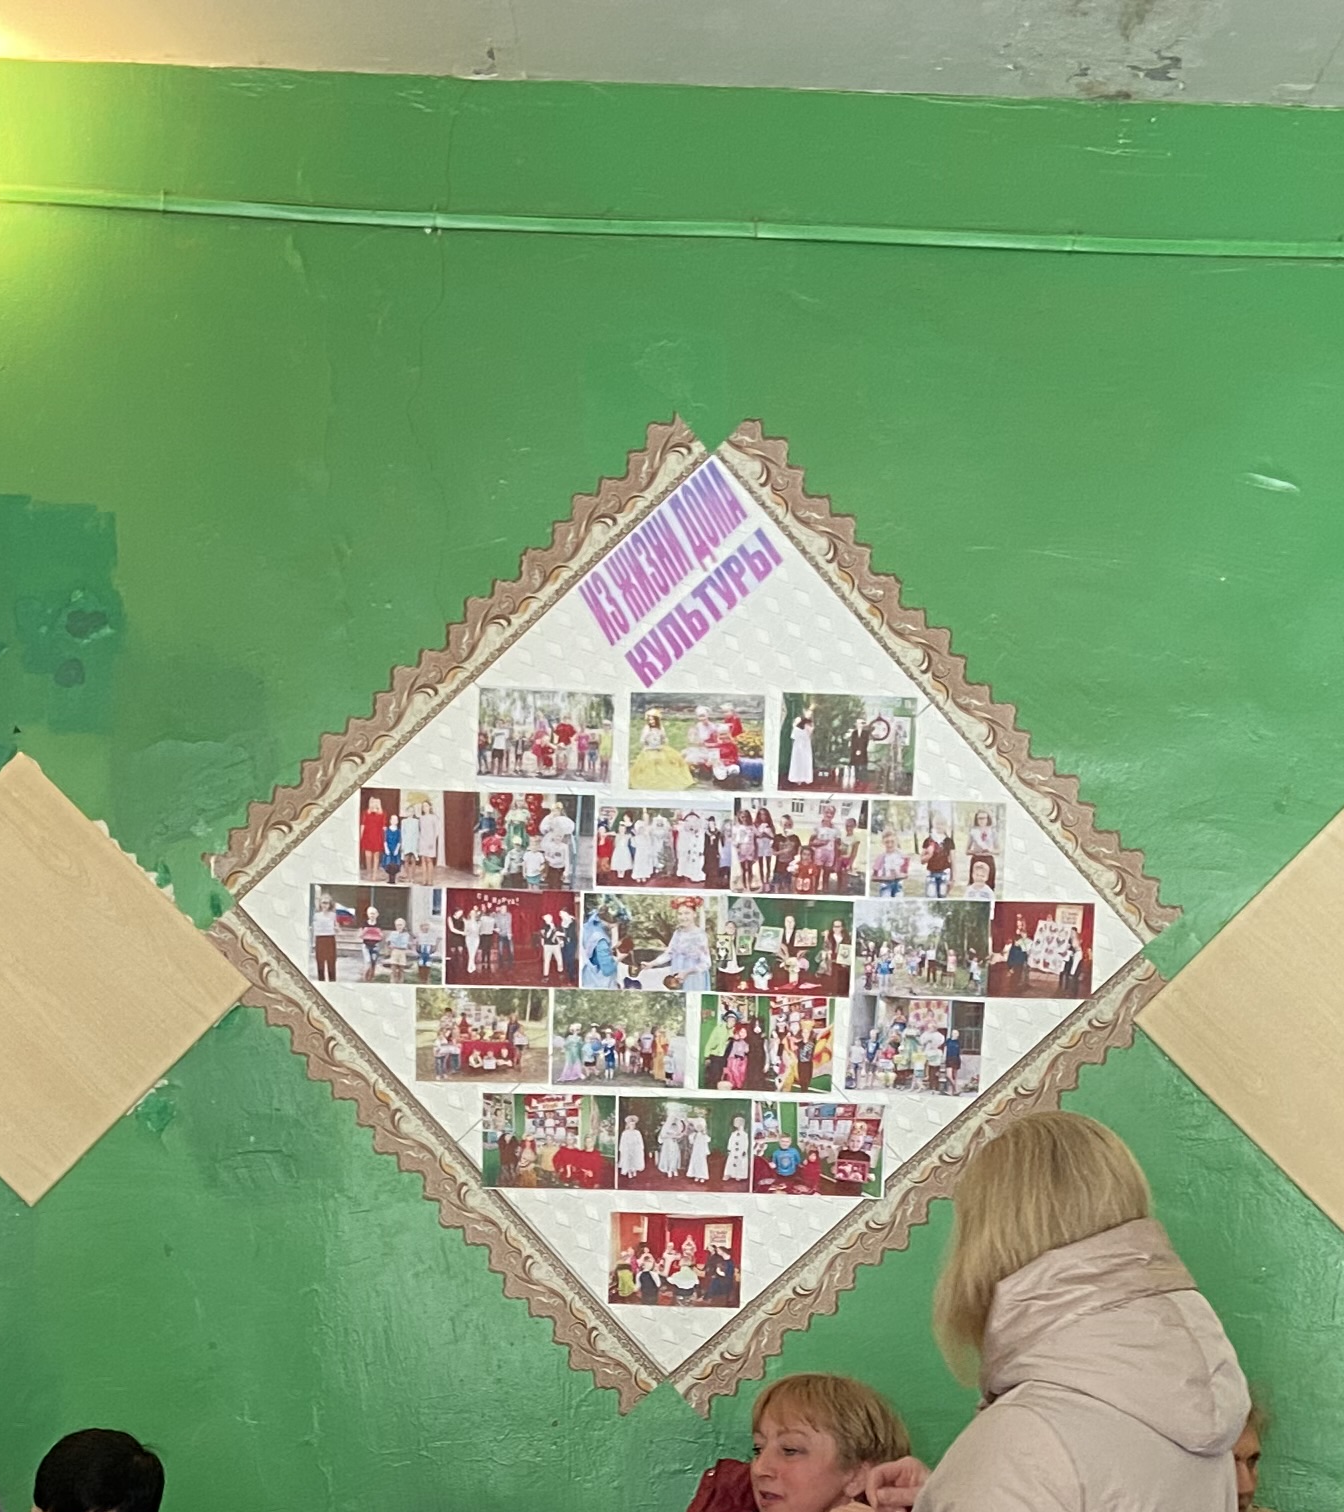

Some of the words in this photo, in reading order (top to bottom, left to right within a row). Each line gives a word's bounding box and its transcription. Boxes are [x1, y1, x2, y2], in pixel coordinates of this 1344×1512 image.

[603, 510, 695, 622] ЖИЗНИ
[667, 460, 748, 572] ДОМА
[578, 572, 630, 646] ИЗ
[624, 527, 784, 689] КУЛЬТУРЫ
